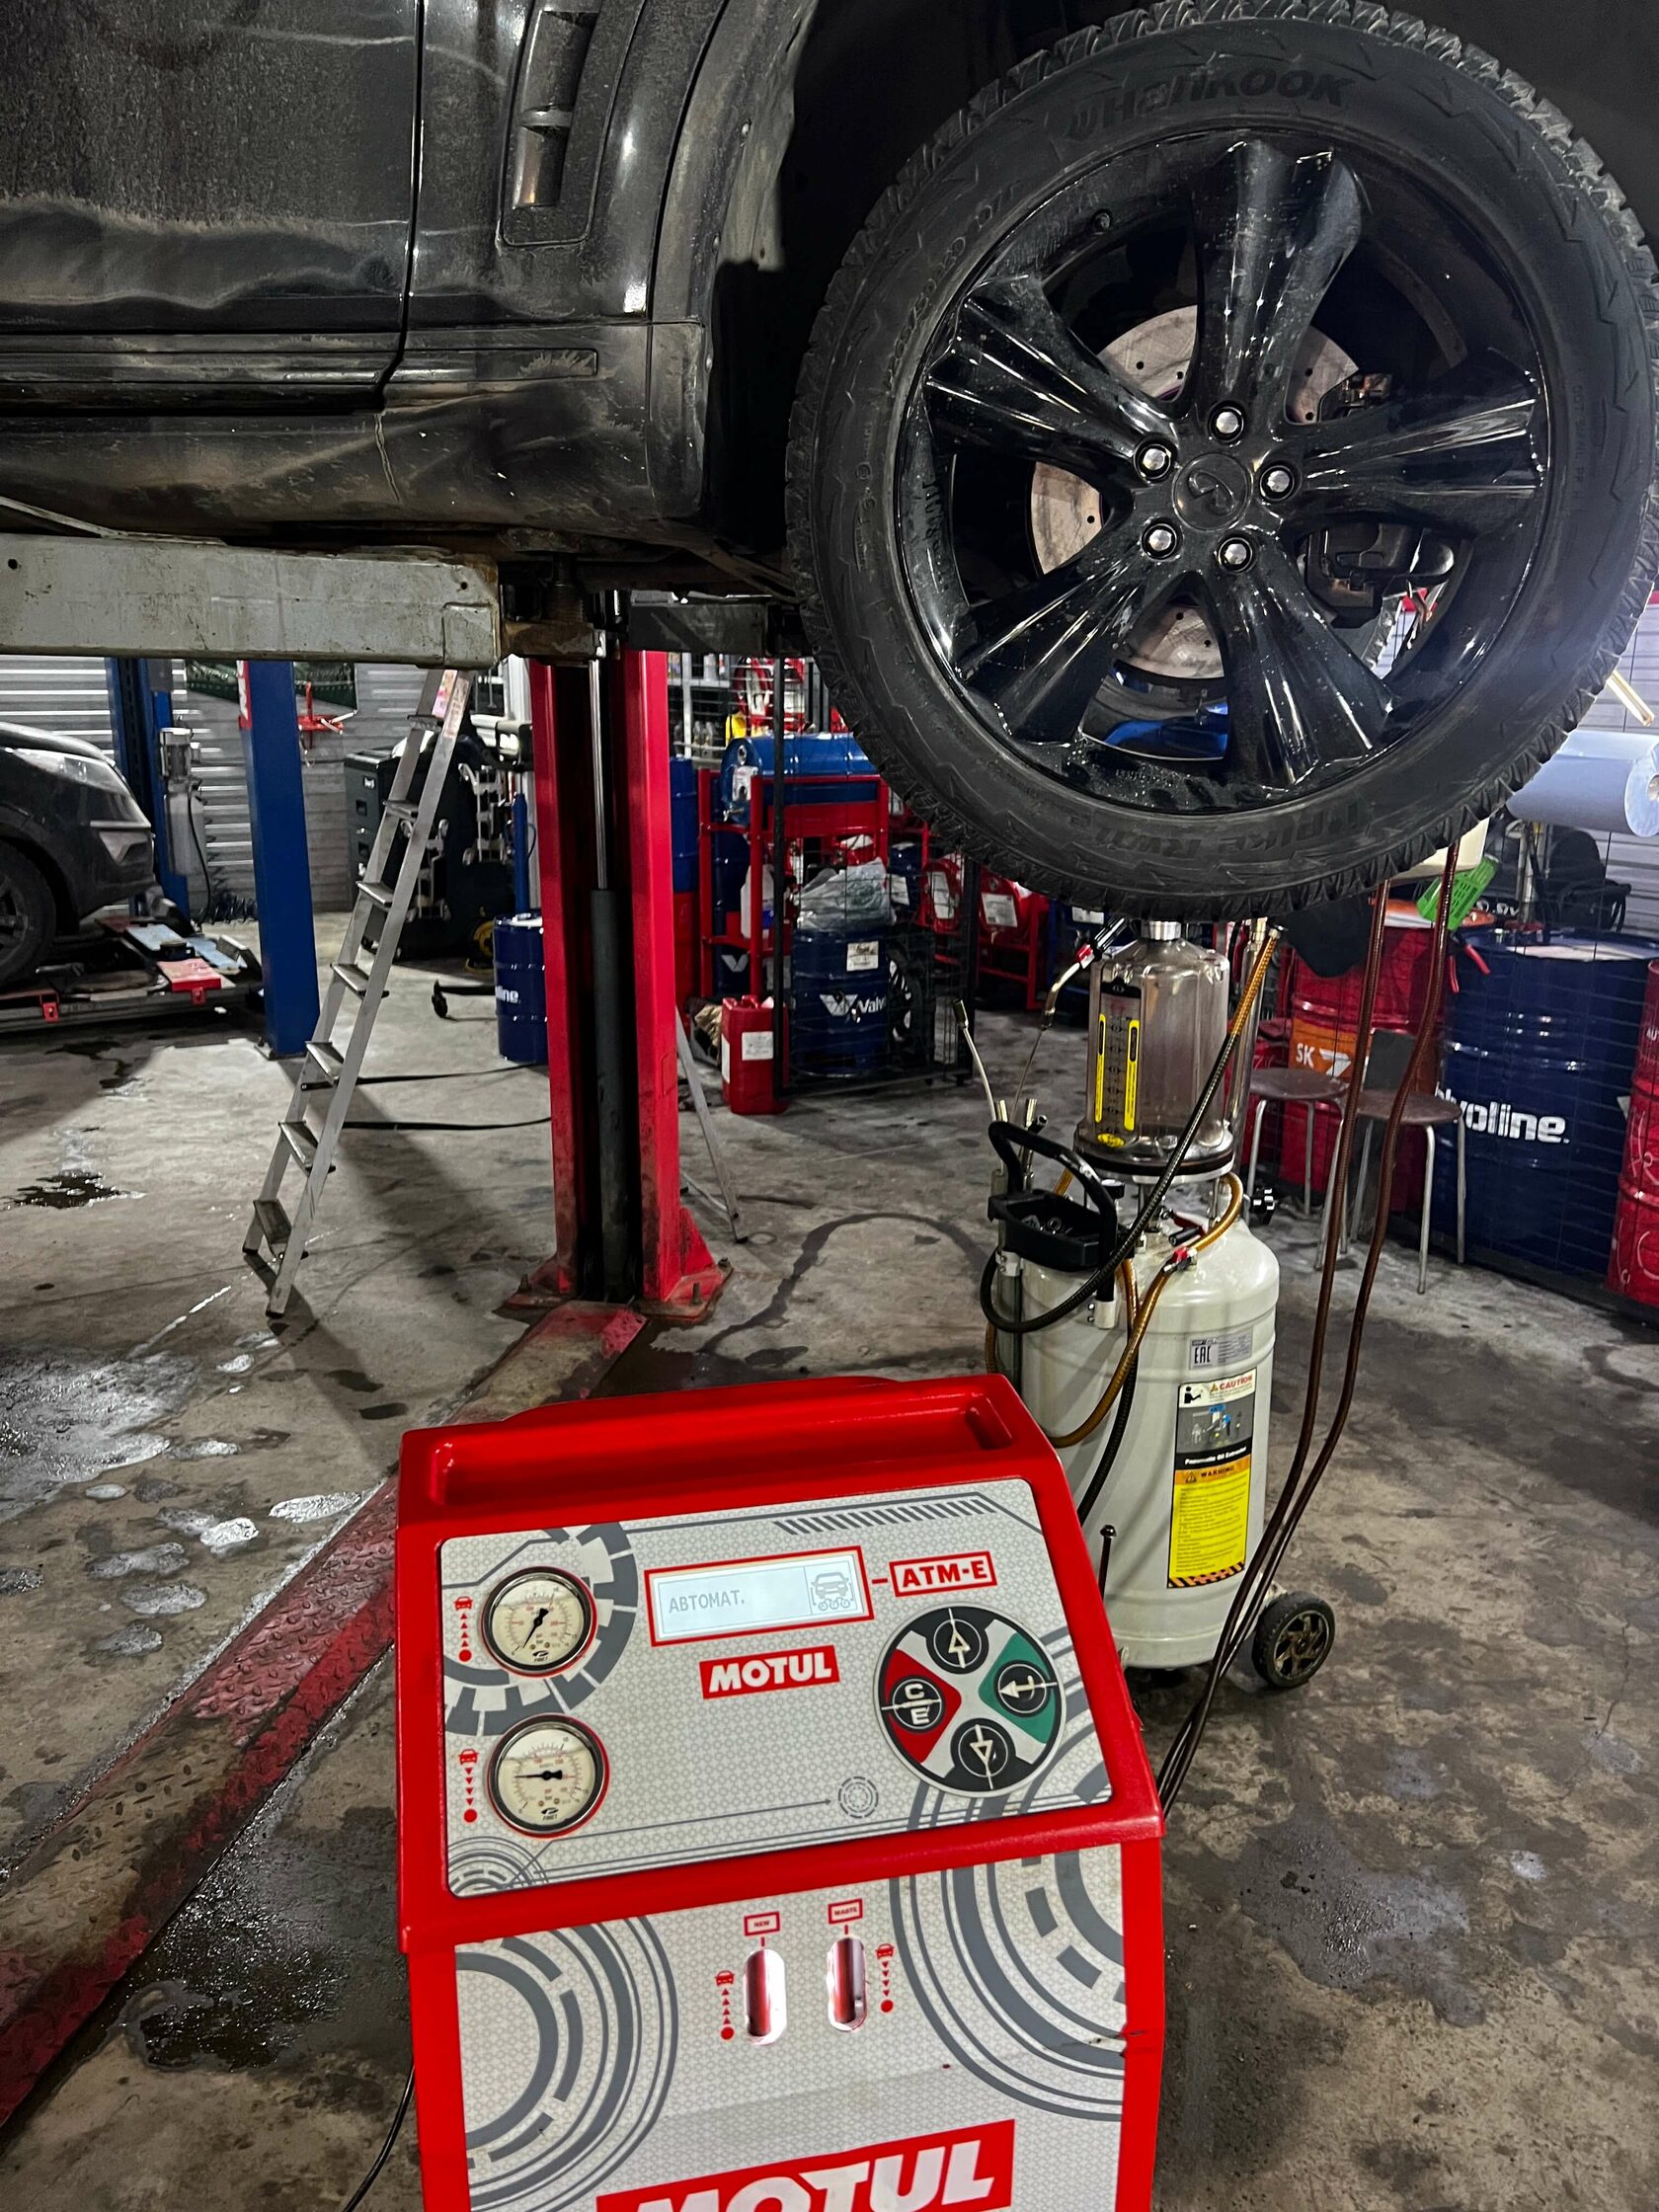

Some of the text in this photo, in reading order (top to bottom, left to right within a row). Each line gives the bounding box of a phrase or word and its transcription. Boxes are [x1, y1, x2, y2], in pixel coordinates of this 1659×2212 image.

[1296, 1042, 1315, 1069] SK
[1194, 1345, 1212, 1364] EAC
[1219, 1375, 1253, 1390] CAUTION
[1200, 1464, 1235, 1478] WARNING
[903, 1560, 988, 1588] ATM-E
[669, 1590, 746, 1614] АВТОМАТ.
[709, 1652, 831, 1693] MOTUL
[905, 1683, 924, 1699] C
[910, 1706, 929, 1725] E
[834, 1907, 857, 1916] WASTE
[636, 2139, 995, 2212] OTUL
